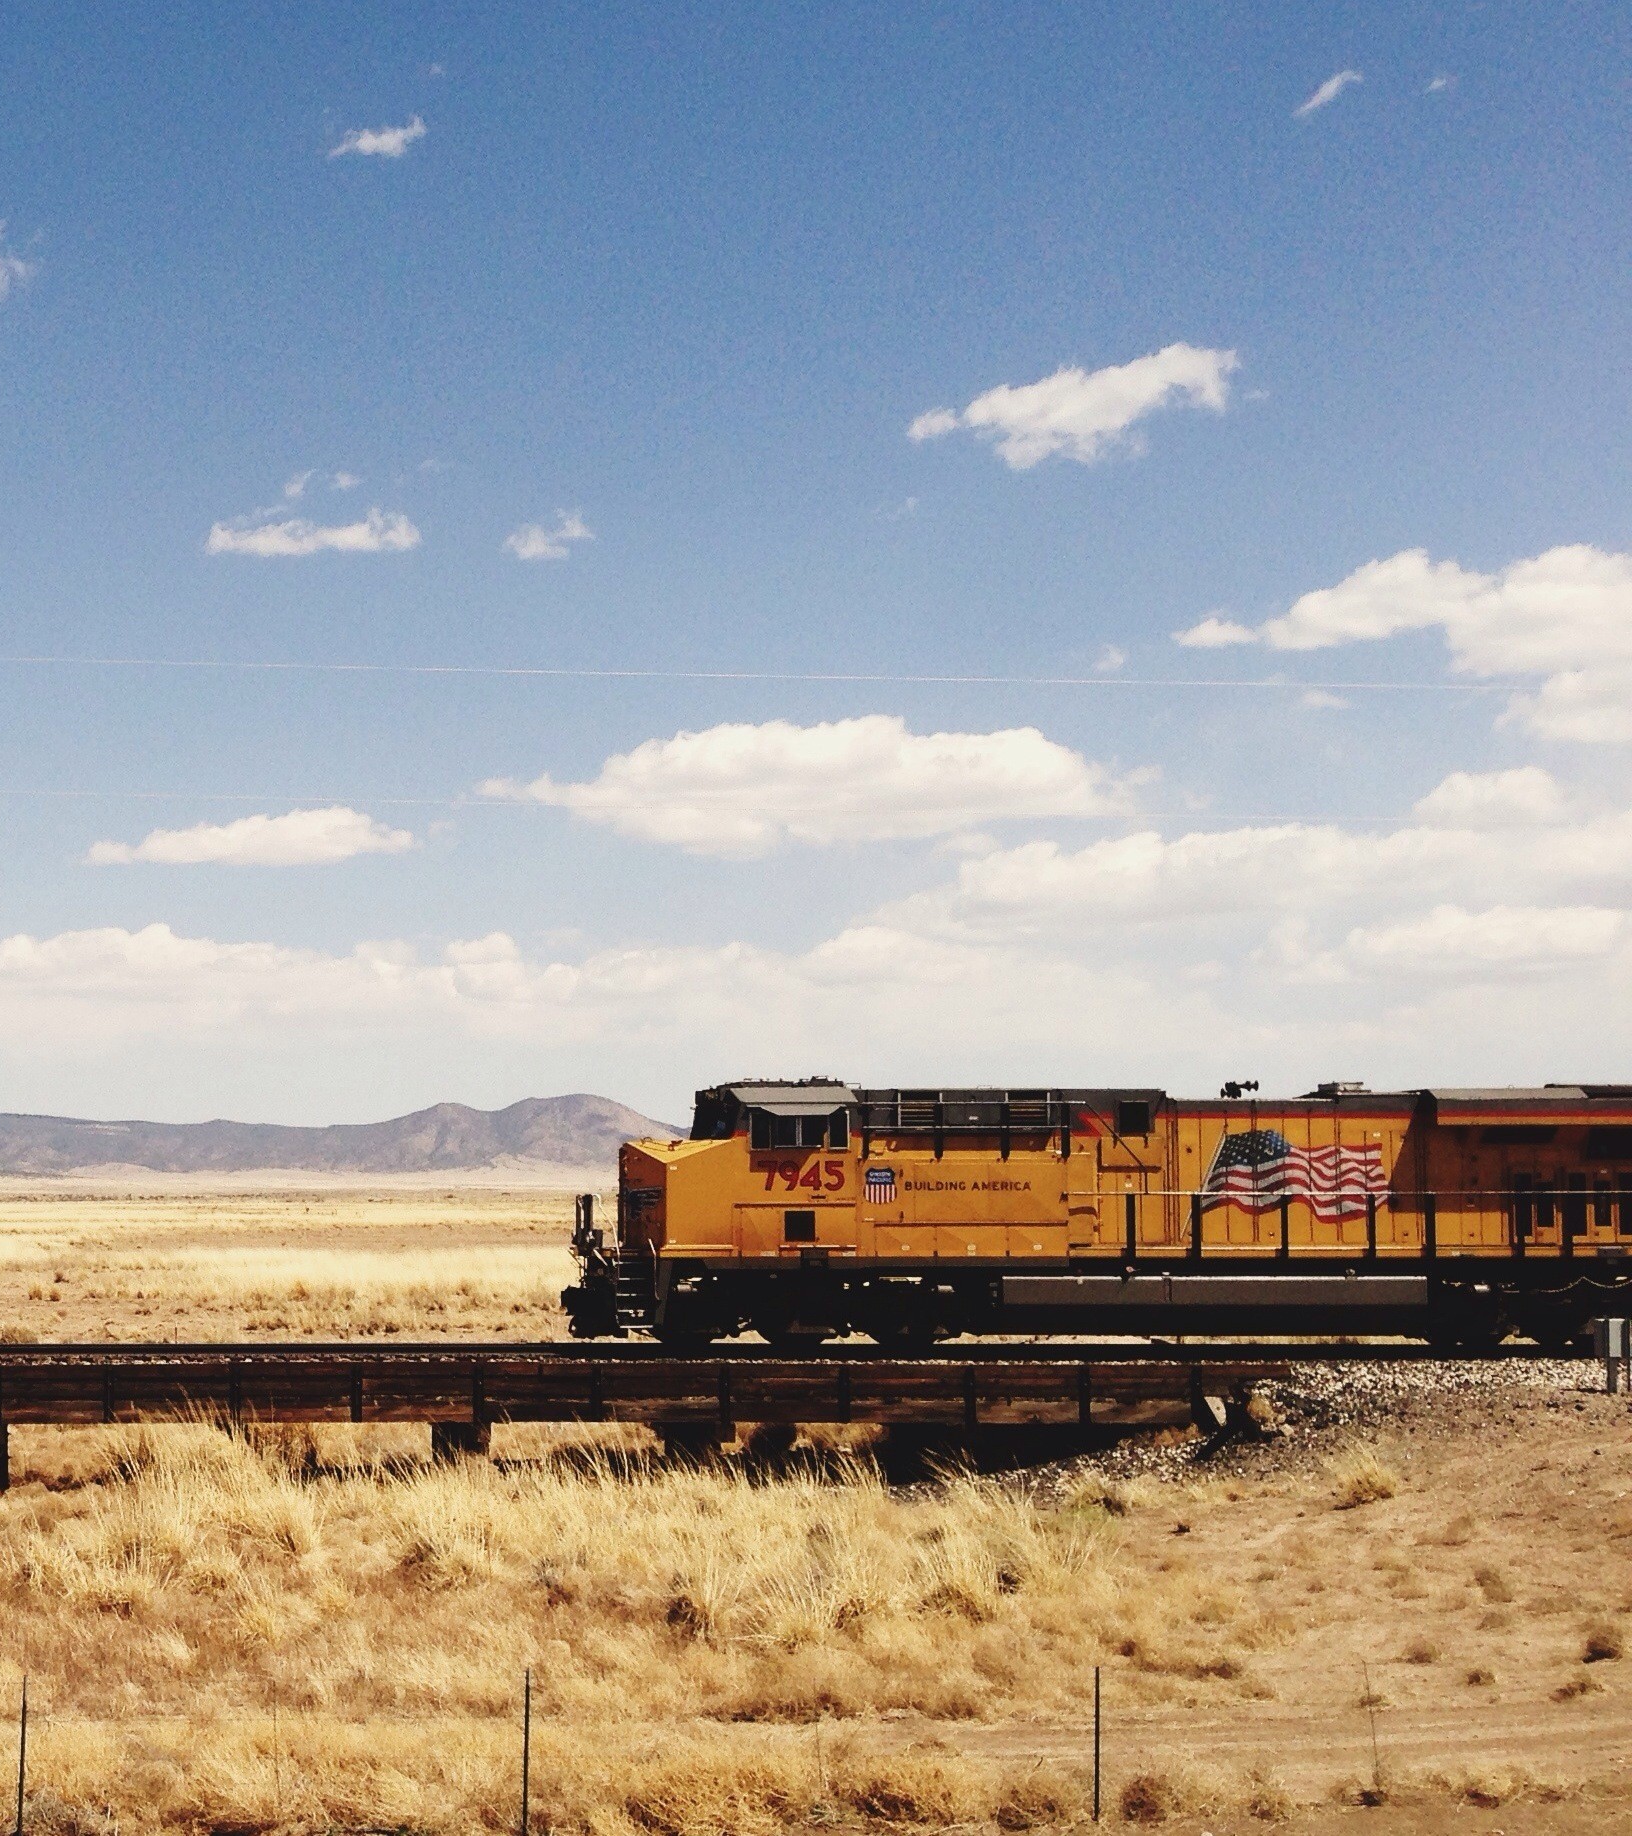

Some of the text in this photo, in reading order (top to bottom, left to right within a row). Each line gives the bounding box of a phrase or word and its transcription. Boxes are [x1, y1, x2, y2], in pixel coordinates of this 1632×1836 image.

[757, 1160, 845, 1191] 7945
[904, 1181, 1031, 1191] BUILDING AMERICA
